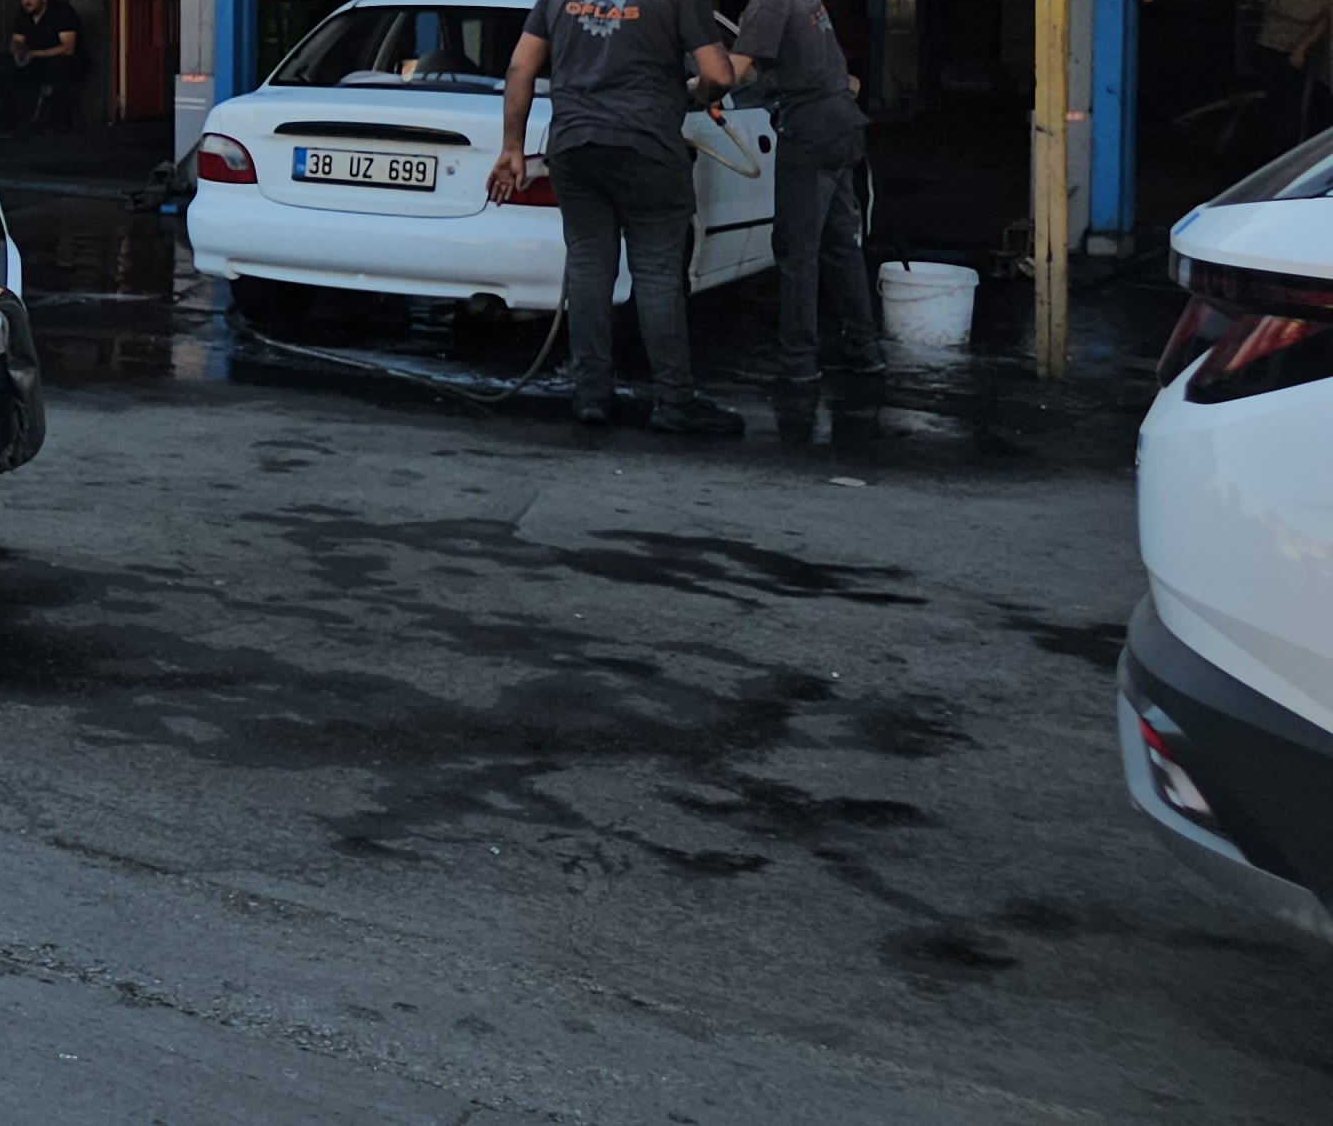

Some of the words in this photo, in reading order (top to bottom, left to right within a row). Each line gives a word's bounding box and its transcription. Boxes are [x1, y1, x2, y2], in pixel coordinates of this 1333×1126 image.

[566, 1, 639, 19] OFLAS
[308, 154, 333, 175] 38
[349, 157, 374, 179] UZ
[389, 160, 427, 183] 699
